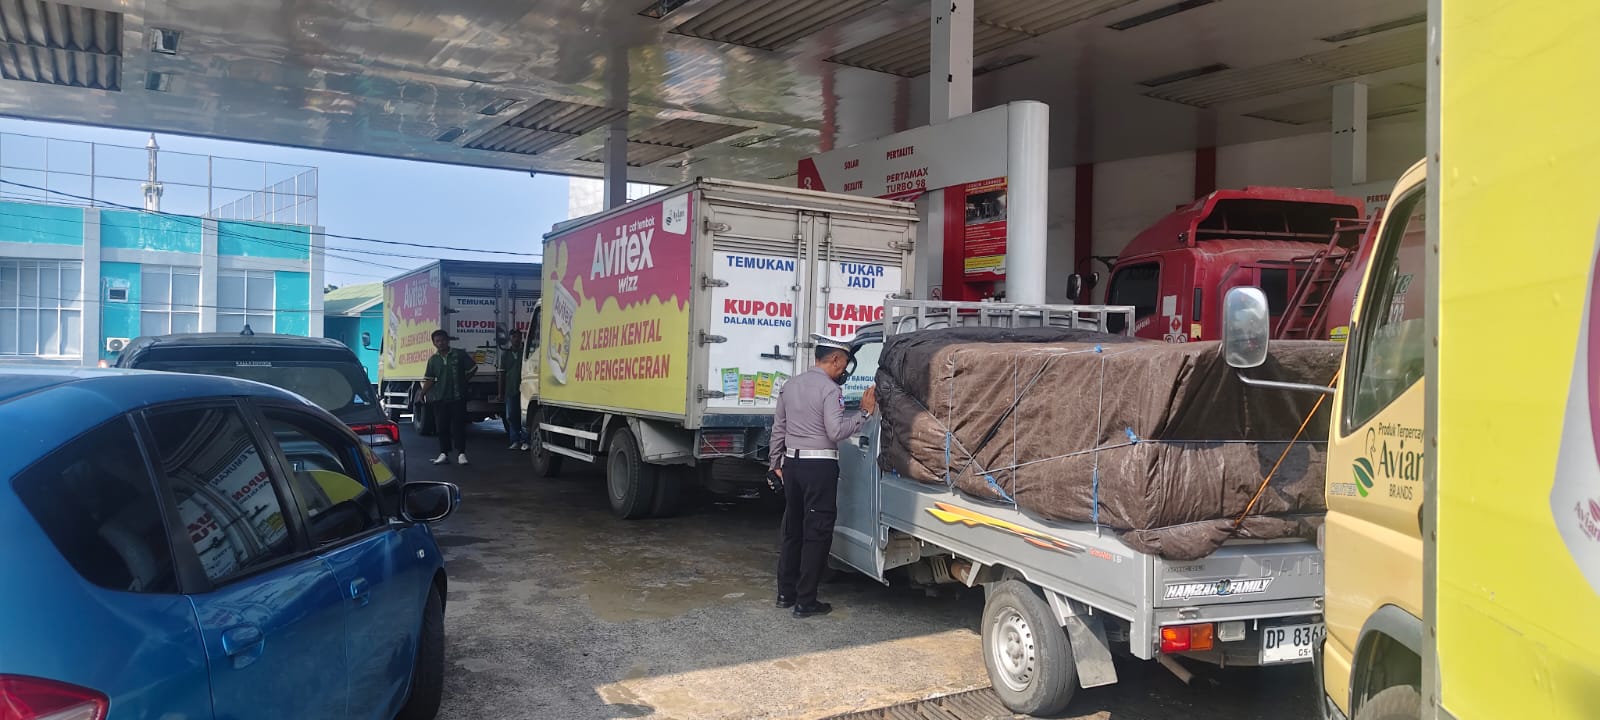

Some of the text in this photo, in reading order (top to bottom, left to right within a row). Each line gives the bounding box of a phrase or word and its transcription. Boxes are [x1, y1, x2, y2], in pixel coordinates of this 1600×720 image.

[886, 146, 914, 160] PERTALITE
[843, 159, 860, 170] SOLAR
[886, 167, 929, 183] PERTAMAX
[843, 181, 863, 192] DEXLITE
[886, 179, 927, 193] TURBO 98
[637, 216, 655, 229] tembok
[590, 225, 655, 280] Avitex
[727, 255, 794, 272] TEMUKAN
[840, 262, 884, 277] TUKAR
[847, 276, 875, 289] JADI
[724, 299, 792, 317] KUPON
[456, 320, 495, 328] KUPON
[724, 316, 792, 328] DALAM KALENG
[580, 318, 662, 351] 2X LEBIH KENTAL
[575, 354, 670, 381] 40% PENGENCERAN
[1379, 422, 1424, 443] Produk Terpercay
[1389, 484, 1413, 500] BRANDS
[1229, 579, 1272, 594] FAMILY
[1266, 629, 1285, 649] DP
